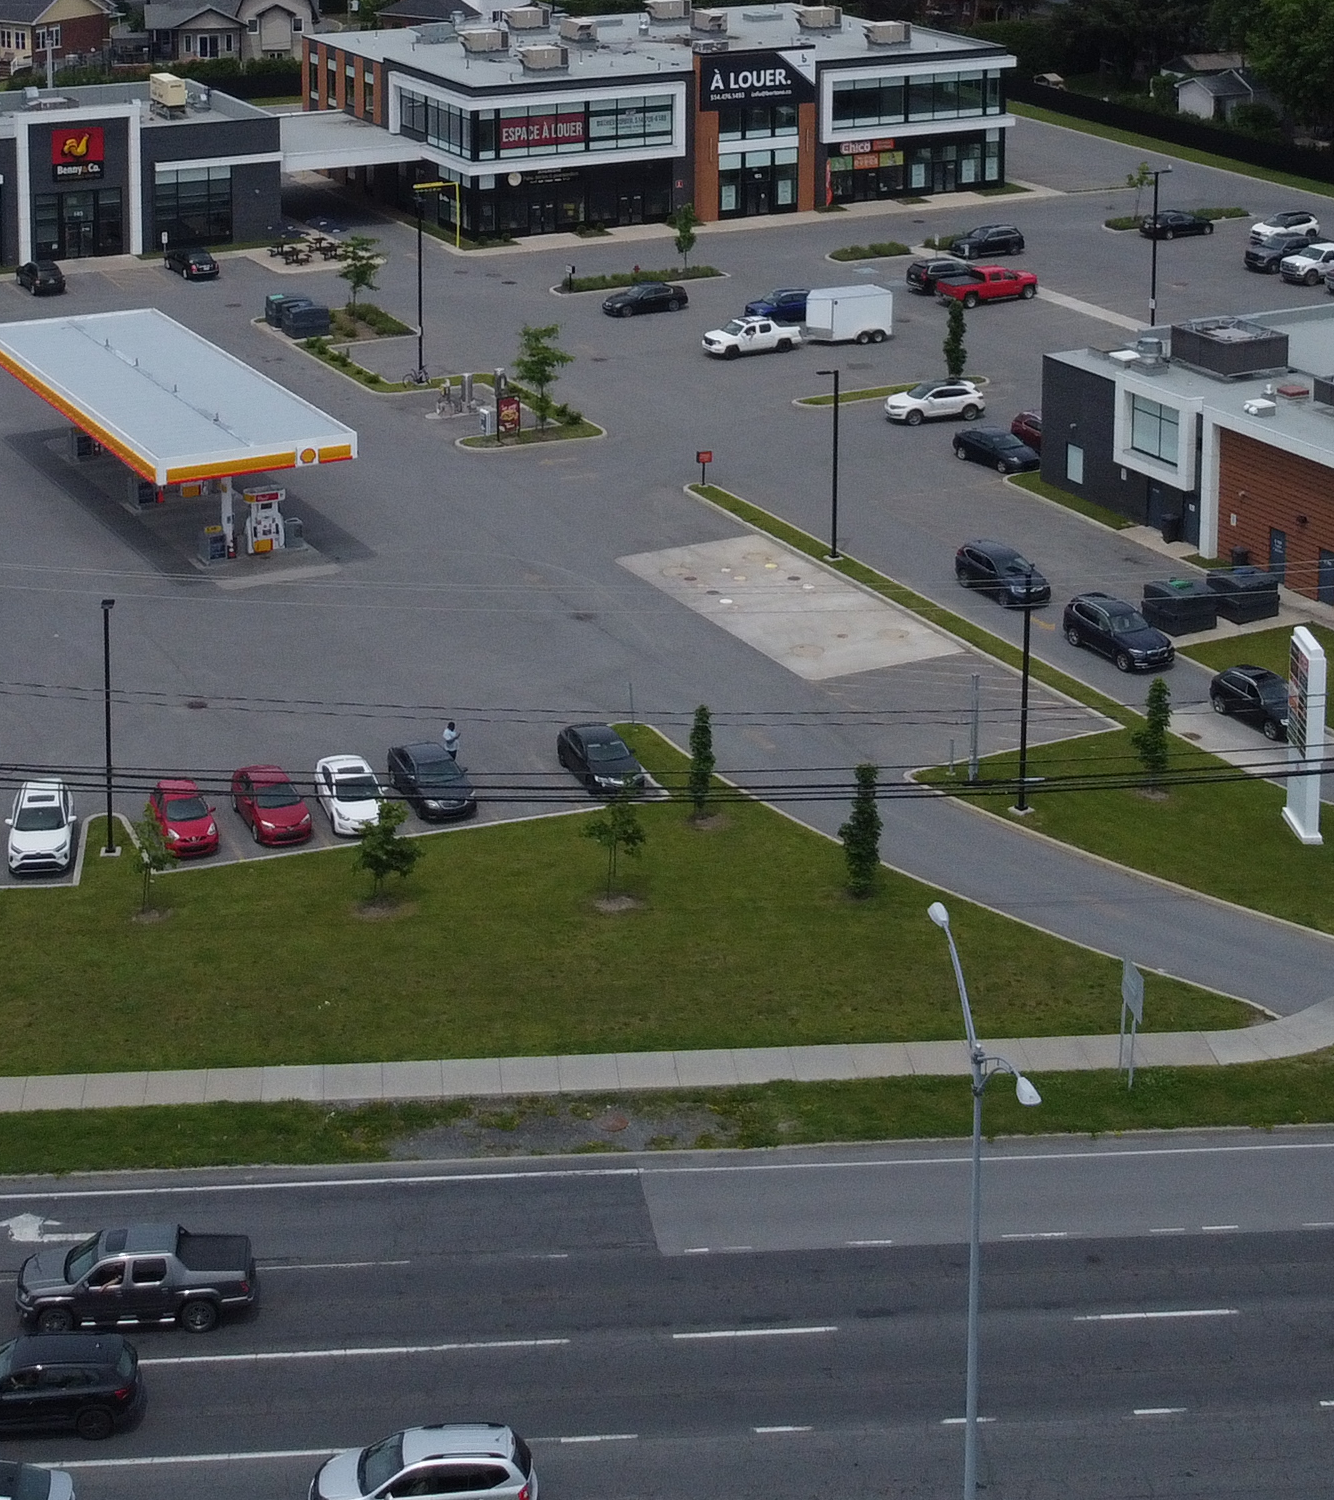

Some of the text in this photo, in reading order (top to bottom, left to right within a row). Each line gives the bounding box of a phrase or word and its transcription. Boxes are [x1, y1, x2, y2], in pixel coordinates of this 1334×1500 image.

[710, 68, 791, 91] À LOUER.
[502, 121, 583, 142] ESPACE À LOUER
